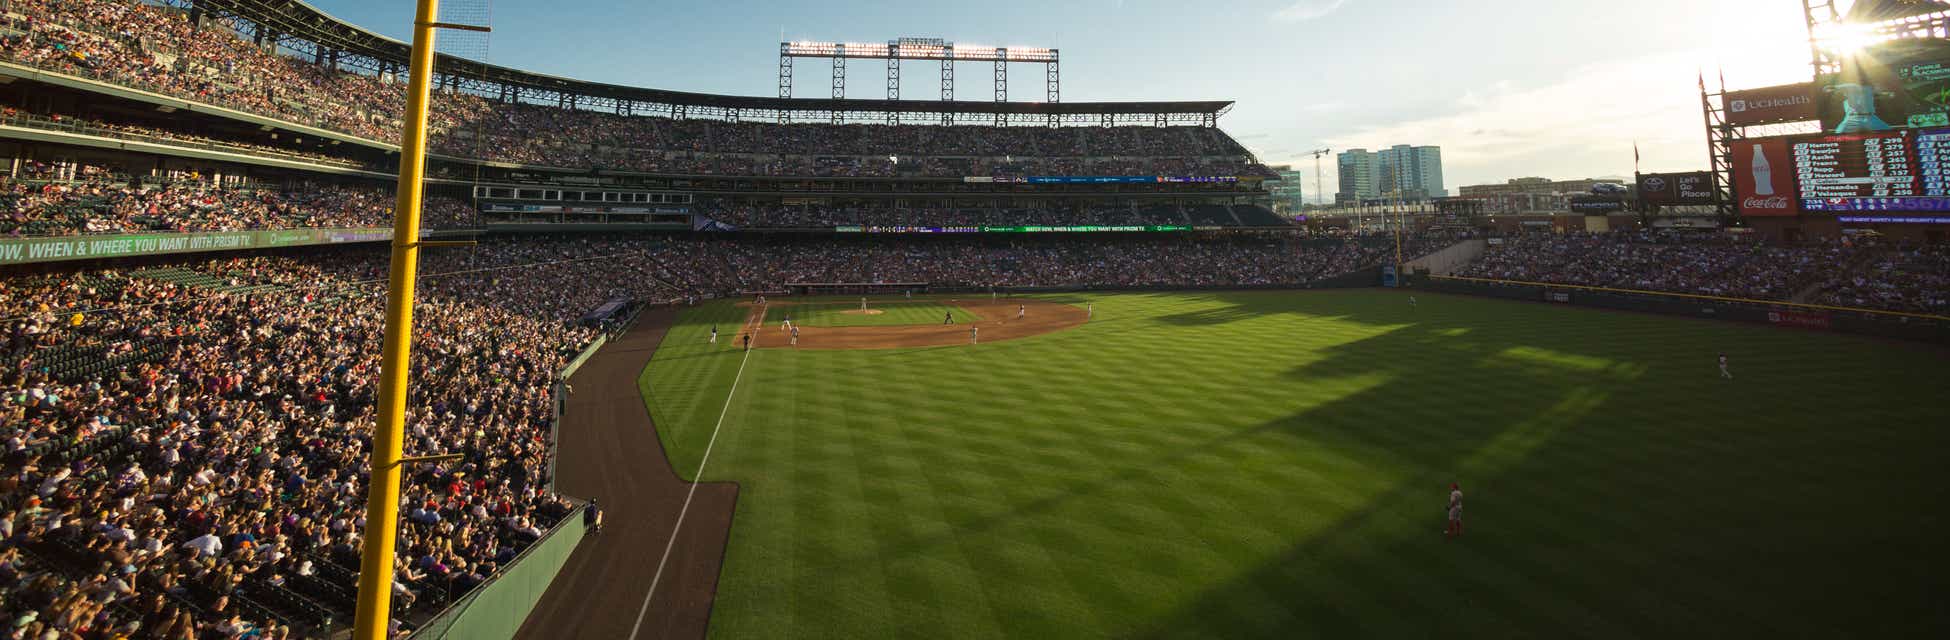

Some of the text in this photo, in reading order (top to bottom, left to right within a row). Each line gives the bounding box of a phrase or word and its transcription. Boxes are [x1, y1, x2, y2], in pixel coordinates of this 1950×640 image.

[1748, 95, 1810, 110] UCHealth
[1681, 190, 1711, 198] Places
[1743, 197, 1787, 209] Coca-Cola
[29, 242, 74, 258] WHEN
[76, 241, 86, 255] &
[90, 239, 132, 254] WHERE
[135, 239, 156, 251] YOU
[159, 238, 189, 250] WANT
[190, 237, 213, 249] WITH
[214, 236, 239, 247] PRISM
